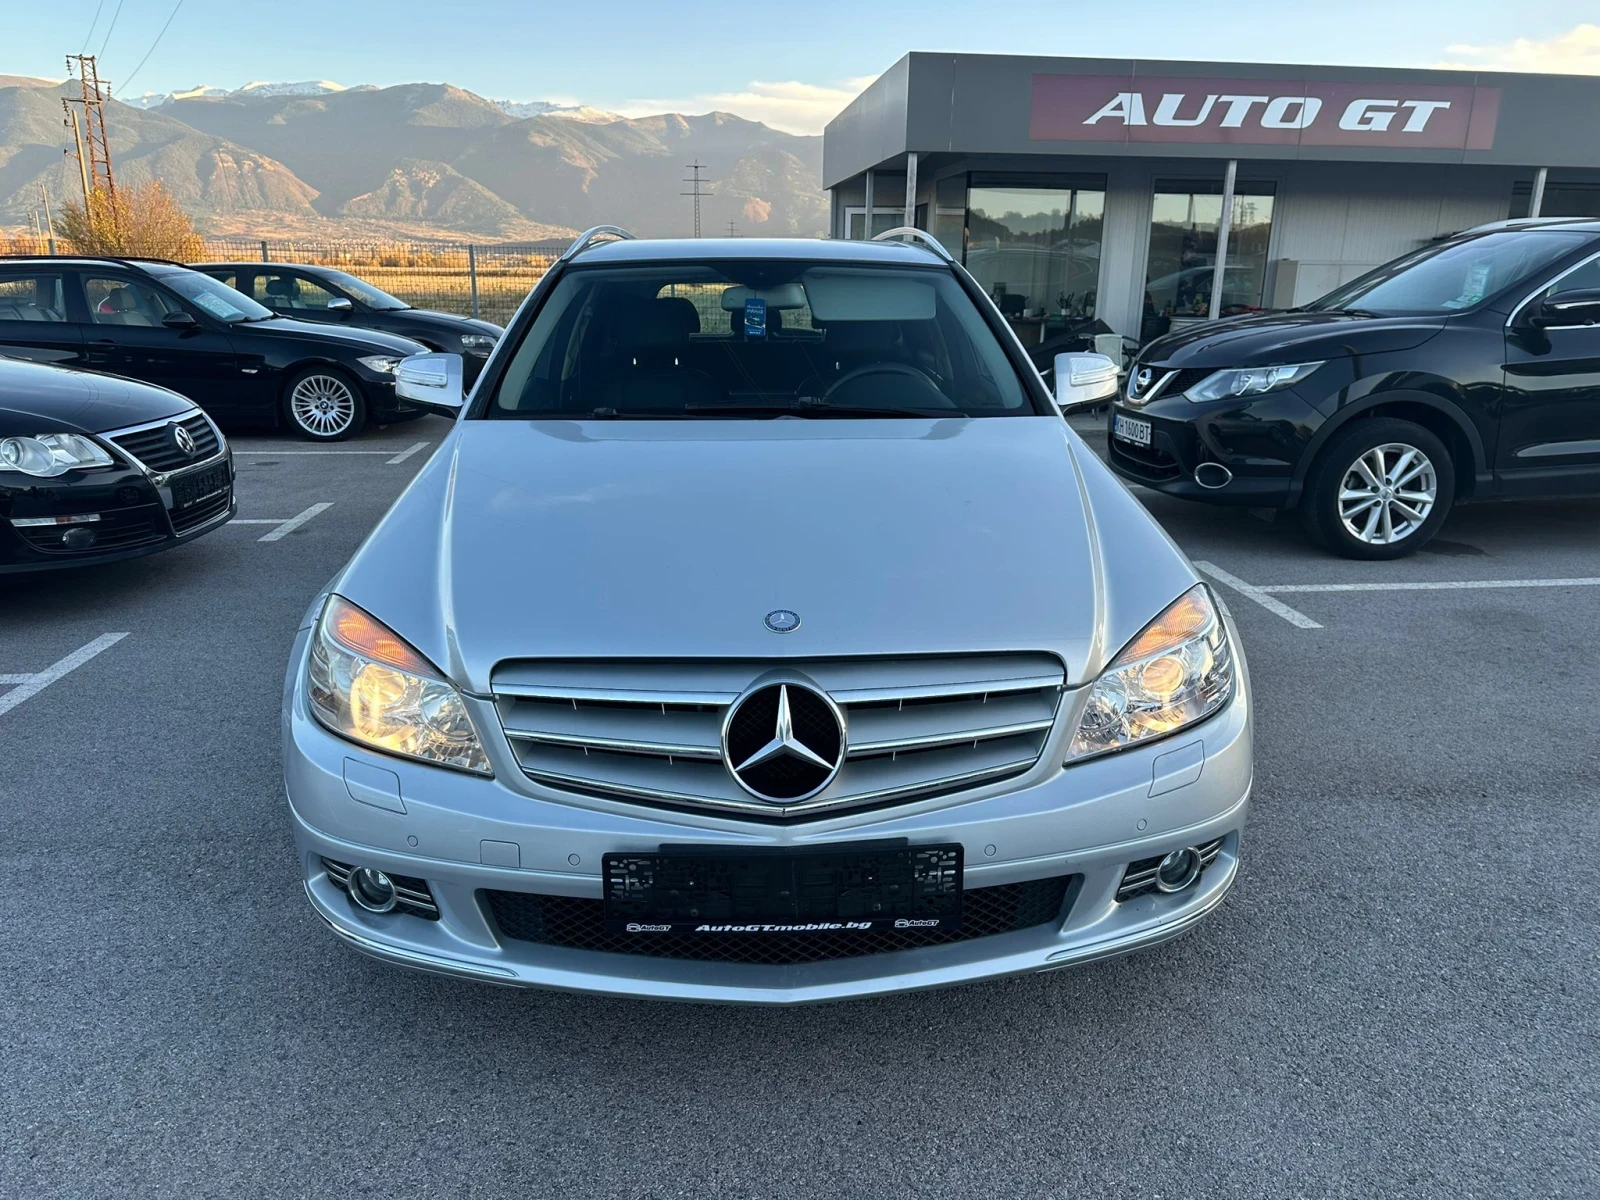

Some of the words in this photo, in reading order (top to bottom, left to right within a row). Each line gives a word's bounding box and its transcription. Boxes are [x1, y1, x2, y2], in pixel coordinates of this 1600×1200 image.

[1082, 92, 1323, 129] AUTO
[1338, 98, 1452, 133] GT
[695, 921, 872, 932] AutoGT.mobile.bg
